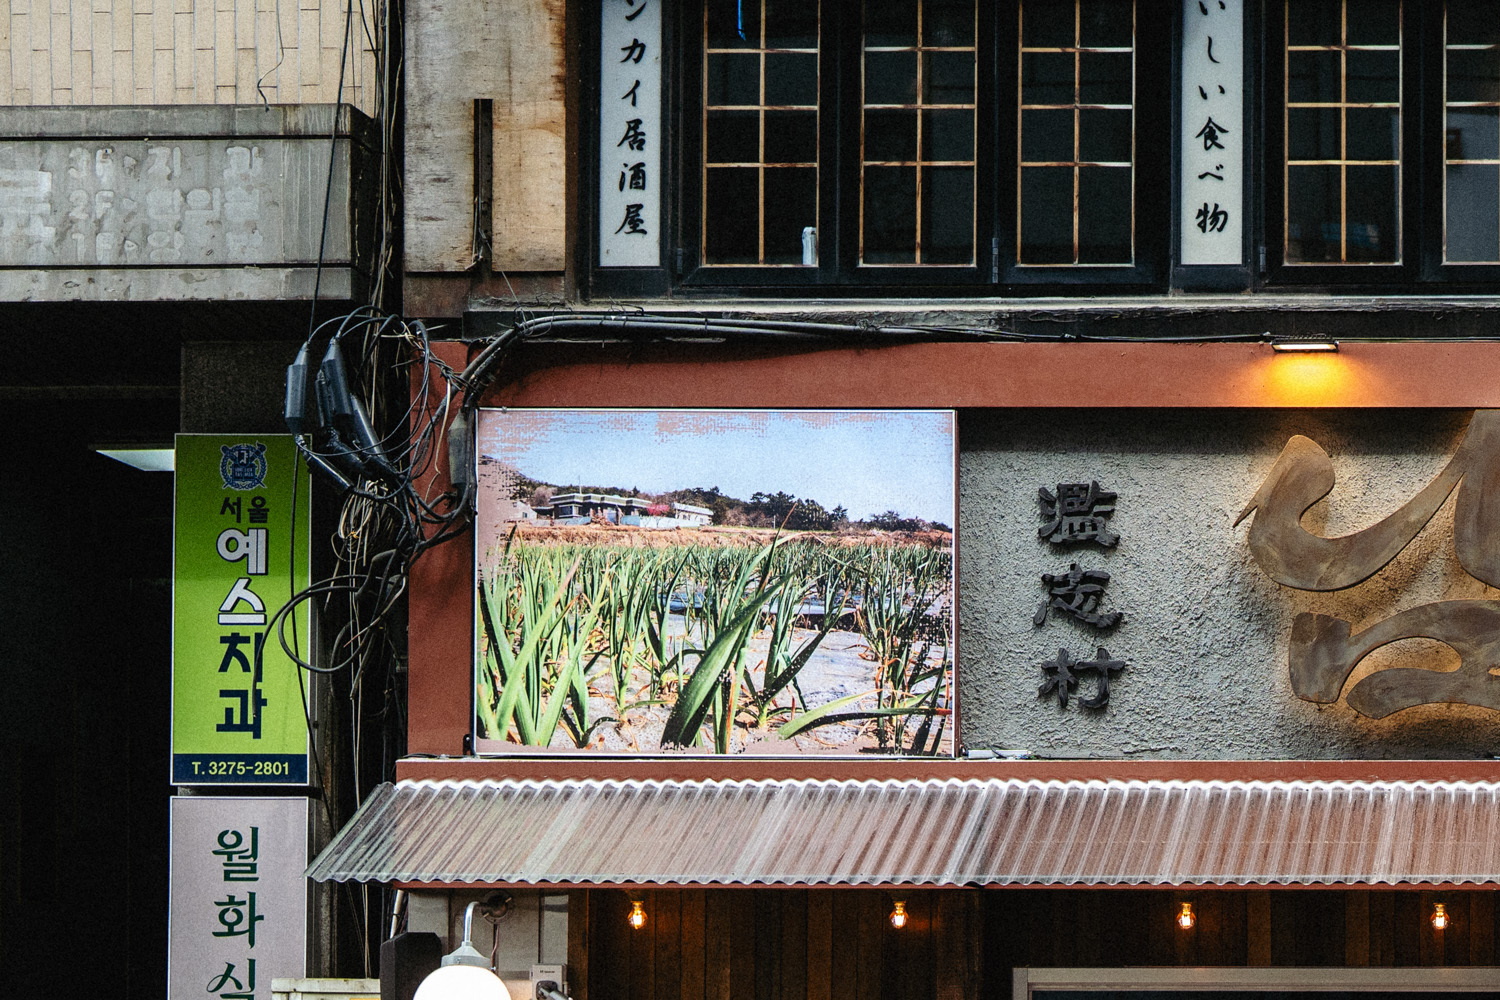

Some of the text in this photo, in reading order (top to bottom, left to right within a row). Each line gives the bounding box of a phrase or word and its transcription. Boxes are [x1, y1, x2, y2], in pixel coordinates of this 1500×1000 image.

[219, 495, 270, 524] 서울
[216, 527, 269, 739] 예스치과
[192, 761, 290, 776] T. 3275-2801
